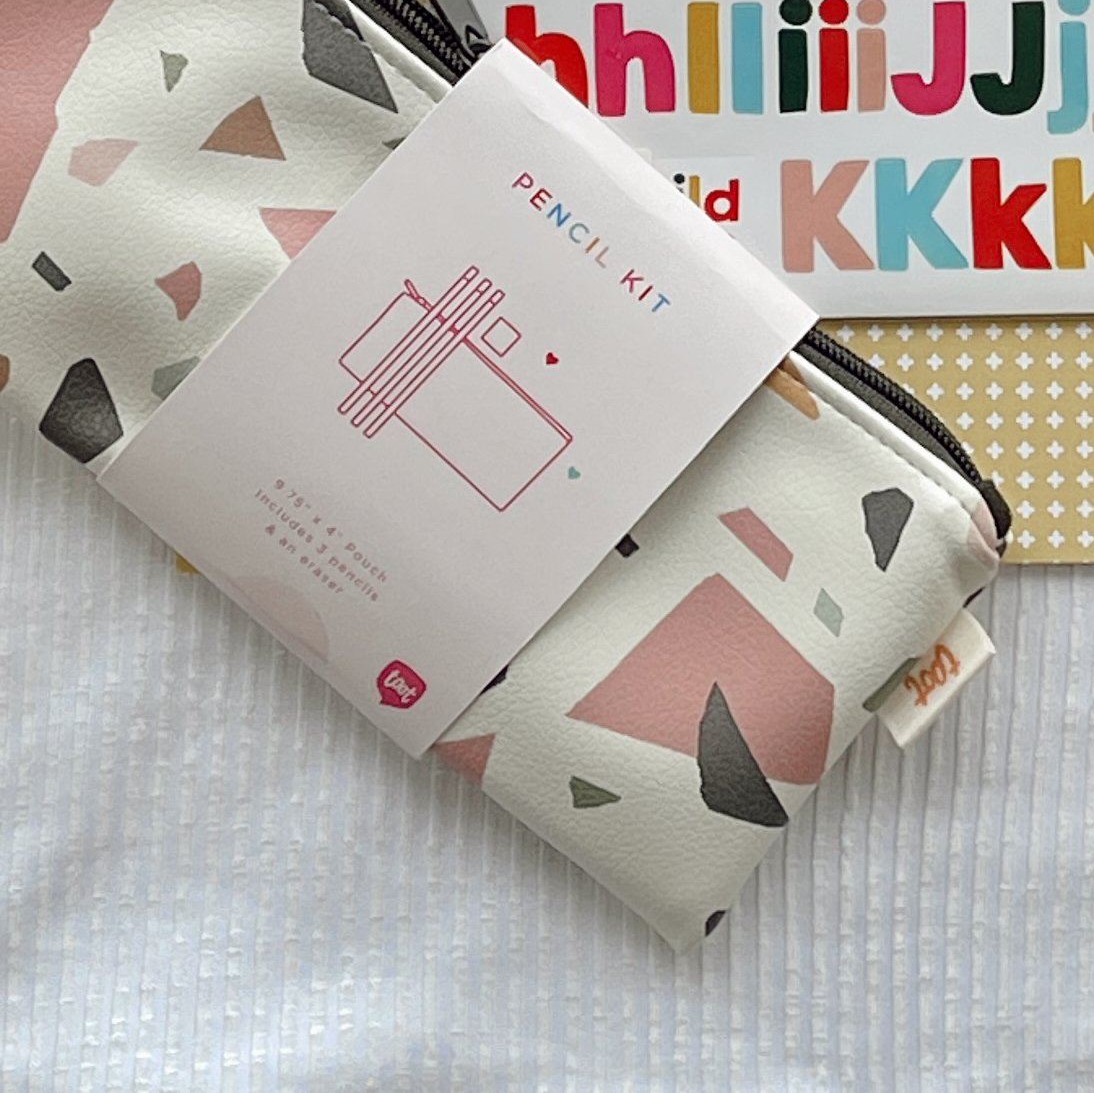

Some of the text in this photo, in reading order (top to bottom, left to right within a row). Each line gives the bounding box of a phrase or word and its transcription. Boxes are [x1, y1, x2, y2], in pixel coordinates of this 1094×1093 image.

[511, 171, 671, 313] PENCIL KIT
[278, 537, 297, 555] an
[299, 555, 344, 595] eraser
[316, 543, 328, 555] 3
[327, 555, 379, 601] pencils
